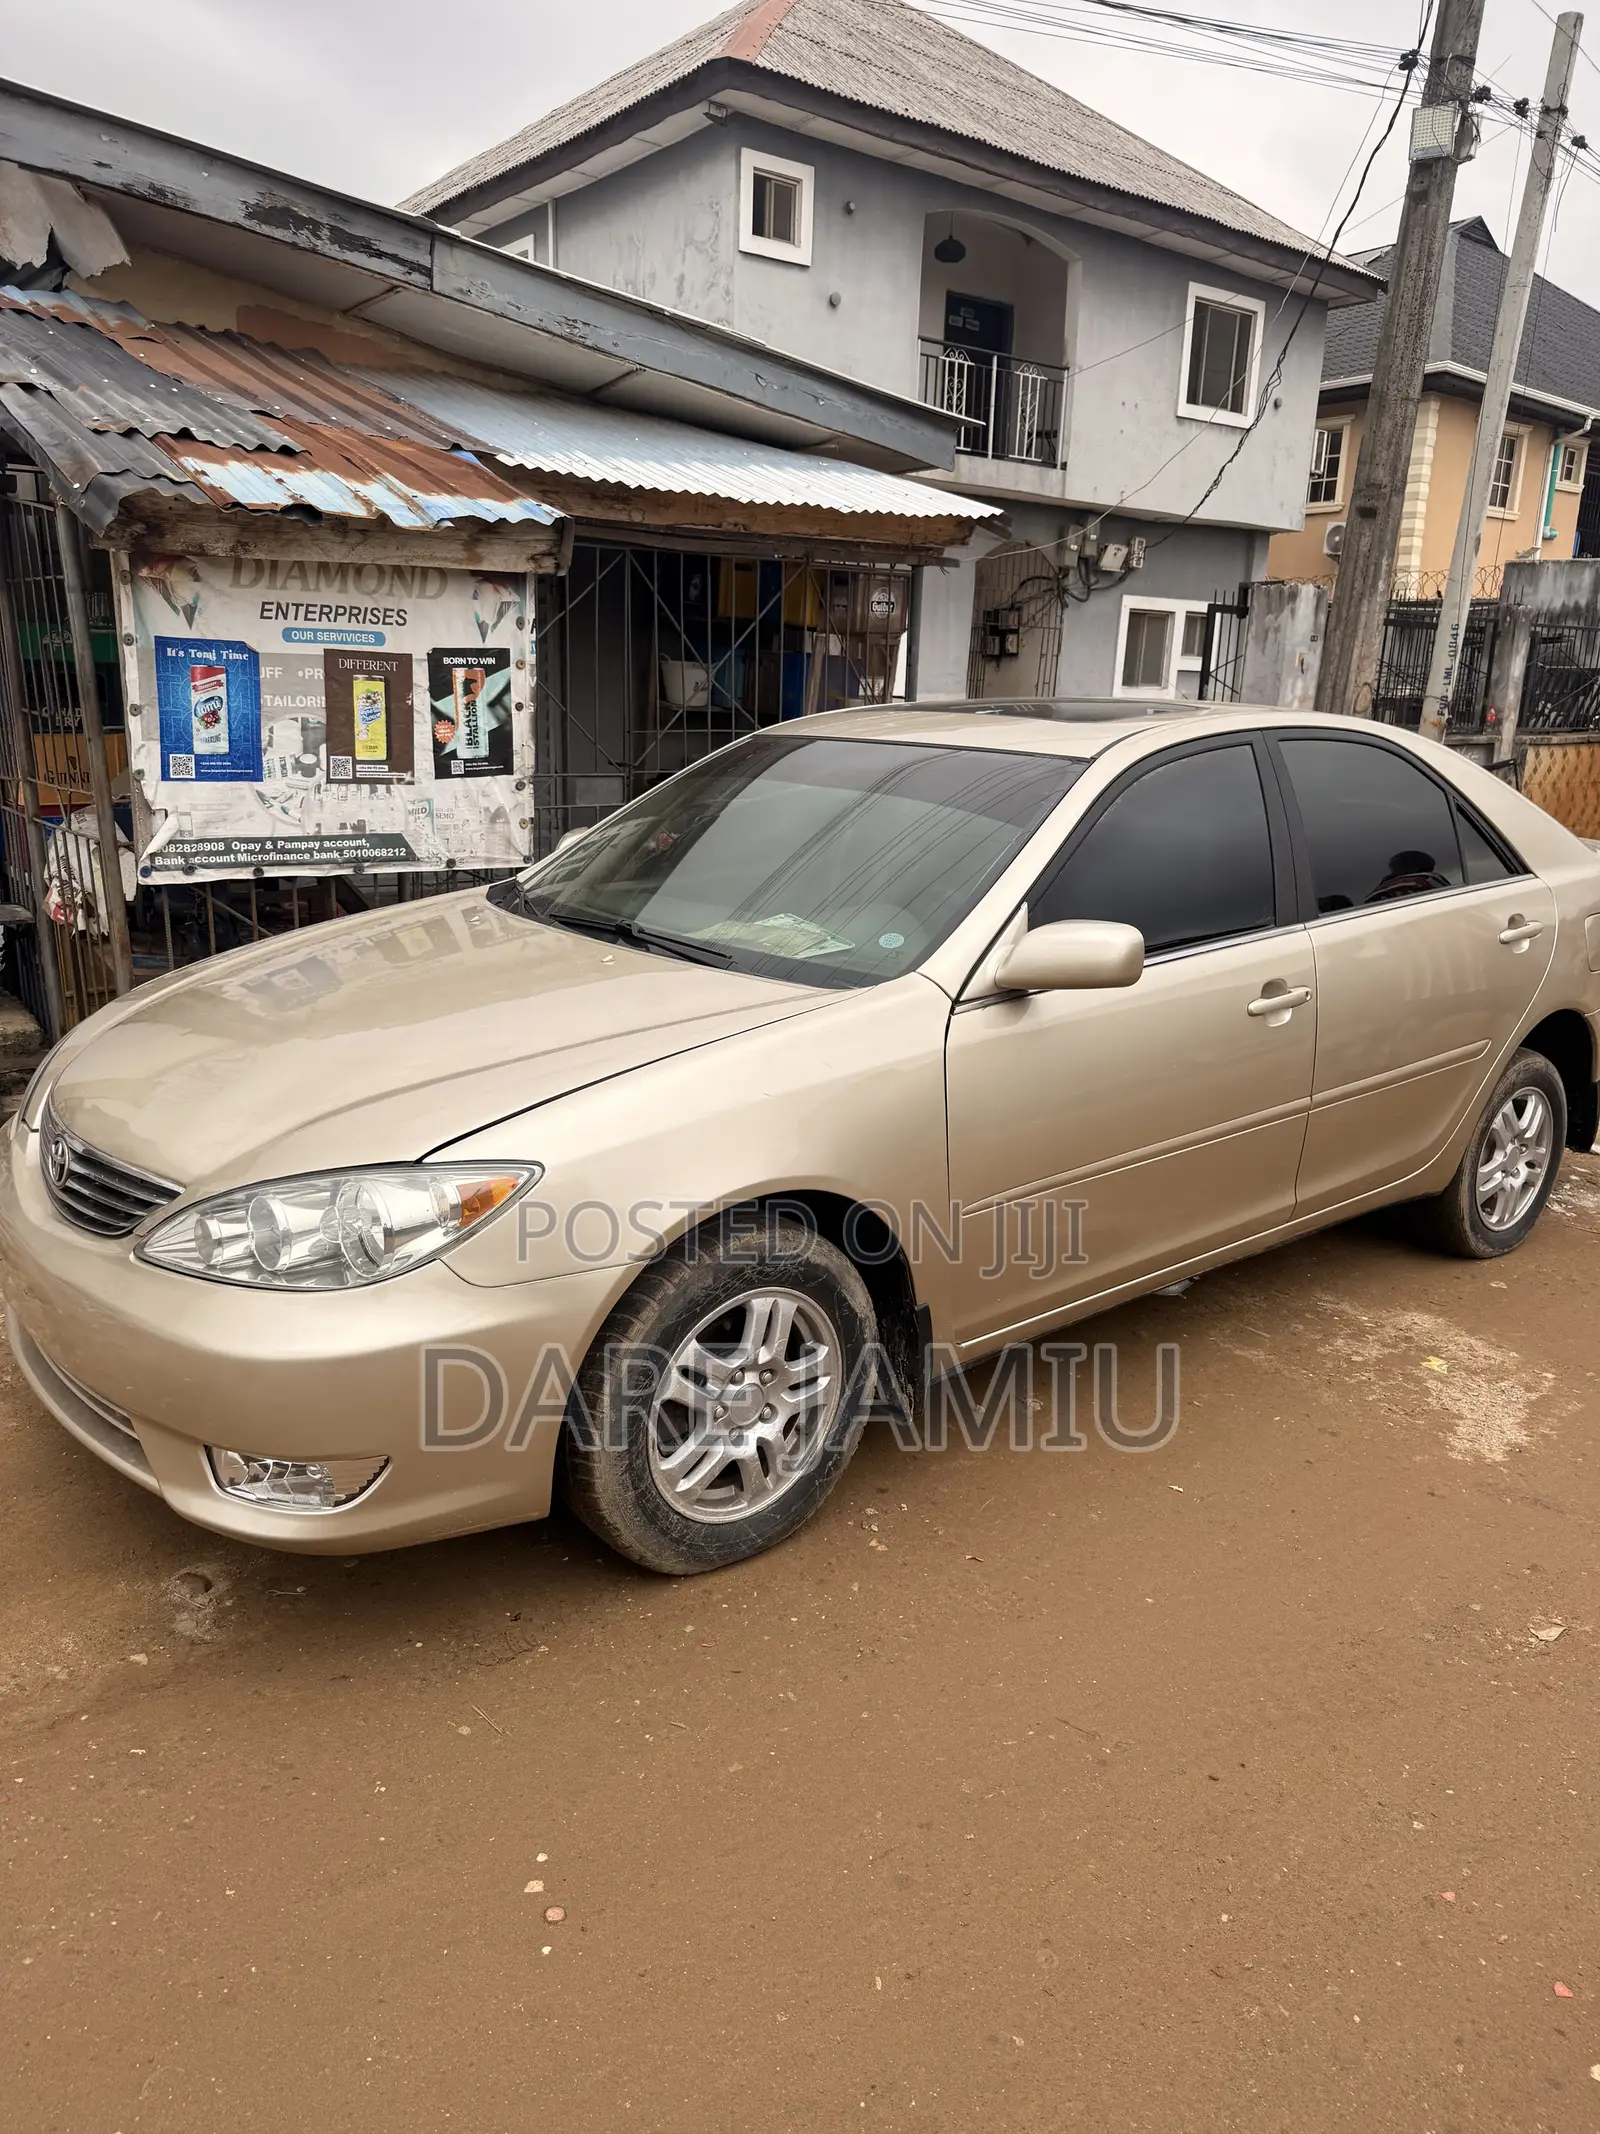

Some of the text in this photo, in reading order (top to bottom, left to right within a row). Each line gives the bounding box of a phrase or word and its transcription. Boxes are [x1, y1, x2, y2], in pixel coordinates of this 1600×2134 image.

[229, 559, 448, 600] DIAMOND
[259, 601, 408, 626] ENTERPRISES
[872, 601, 894, 612] Guldr
[291, 630, 375, 643] OUR SERVIVICES
[166, 647, 249, 660] It's Tomi Time
[339, 658, 398, 672] DIFFERENT
[443, 657, 496, 665] BORN TO WIN
[260, 667, 325, 679] UFF PR
[472, 700, 480, 746] STALLION
[158, 838, 370, 853] 082828908 Opay & Pampay account,
[155, 856, 185, 865] Bank
[237, 852, 310, 862] Microfinance
[313, 850, 340, 859] bank
[343, 848, 406, 858] 5010068212
